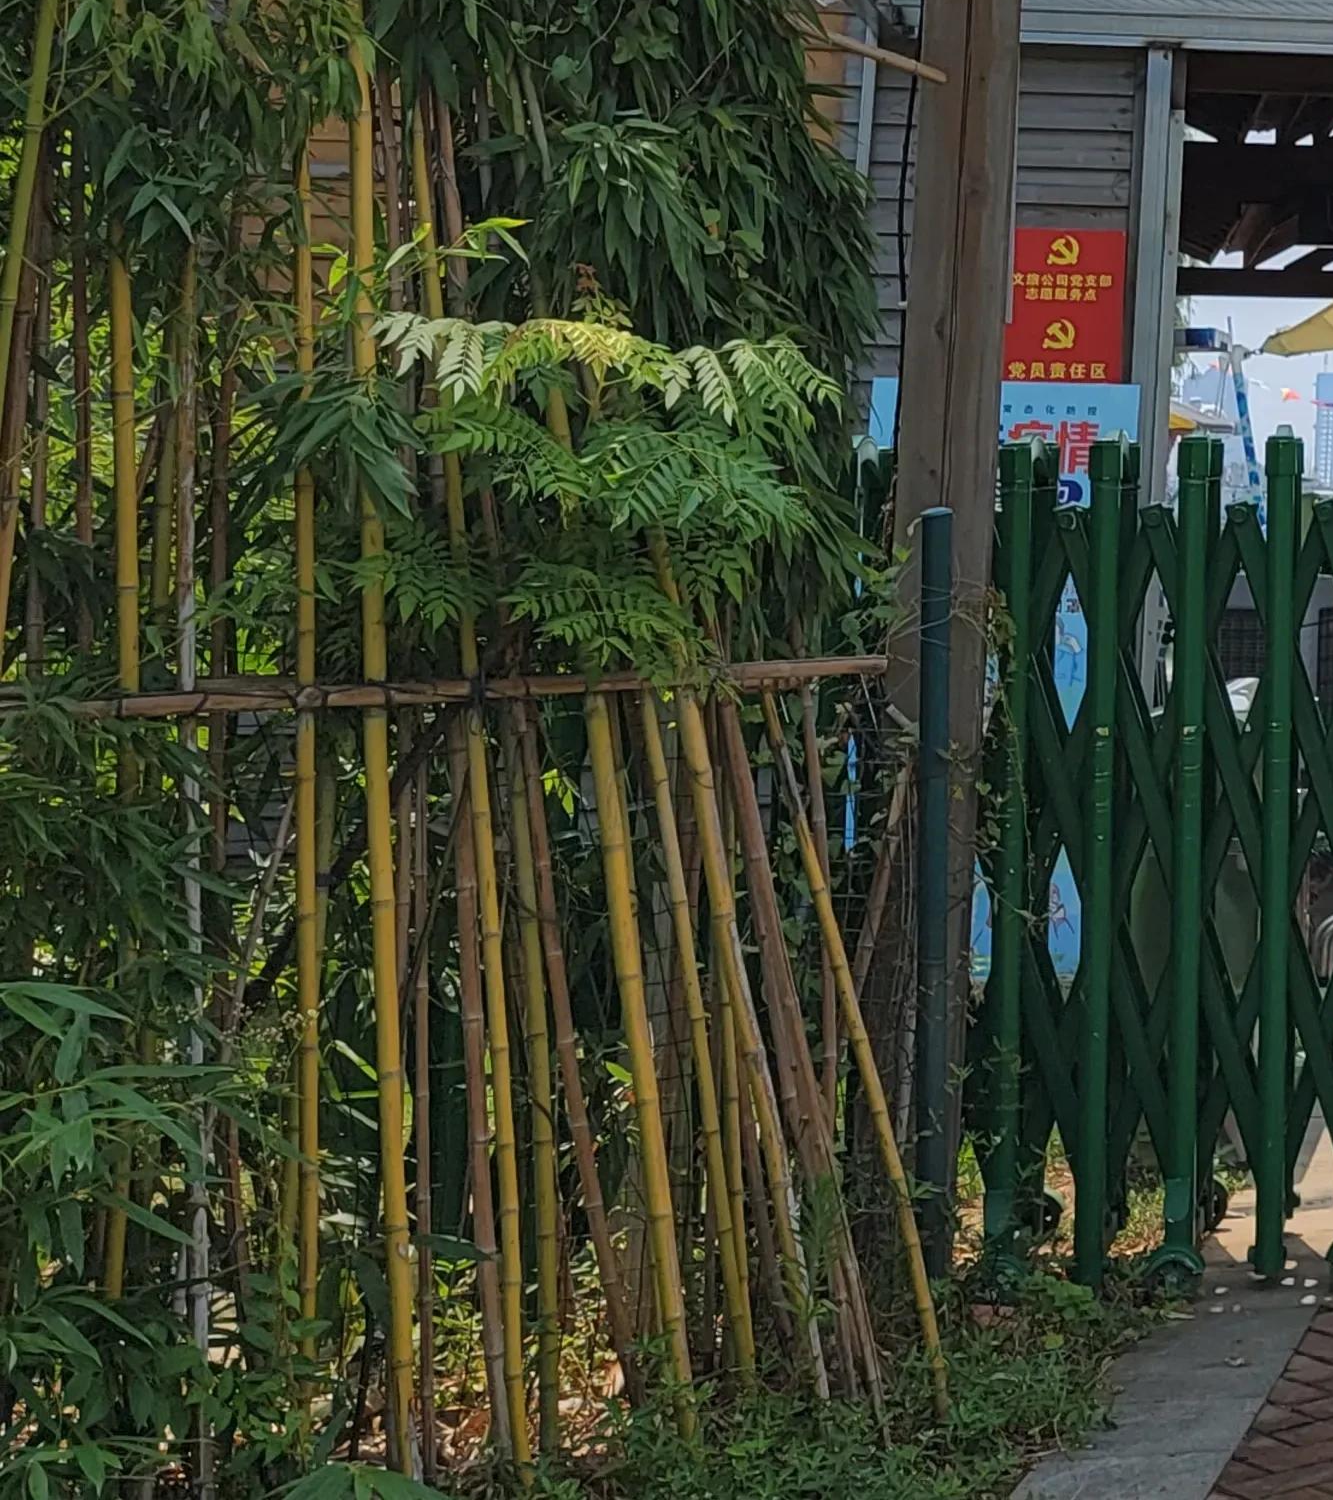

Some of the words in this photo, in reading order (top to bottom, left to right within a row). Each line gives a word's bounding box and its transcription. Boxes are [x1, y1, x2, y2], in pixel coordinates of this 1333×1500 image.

[1008, 361, 1108, 380] 党员责任区
